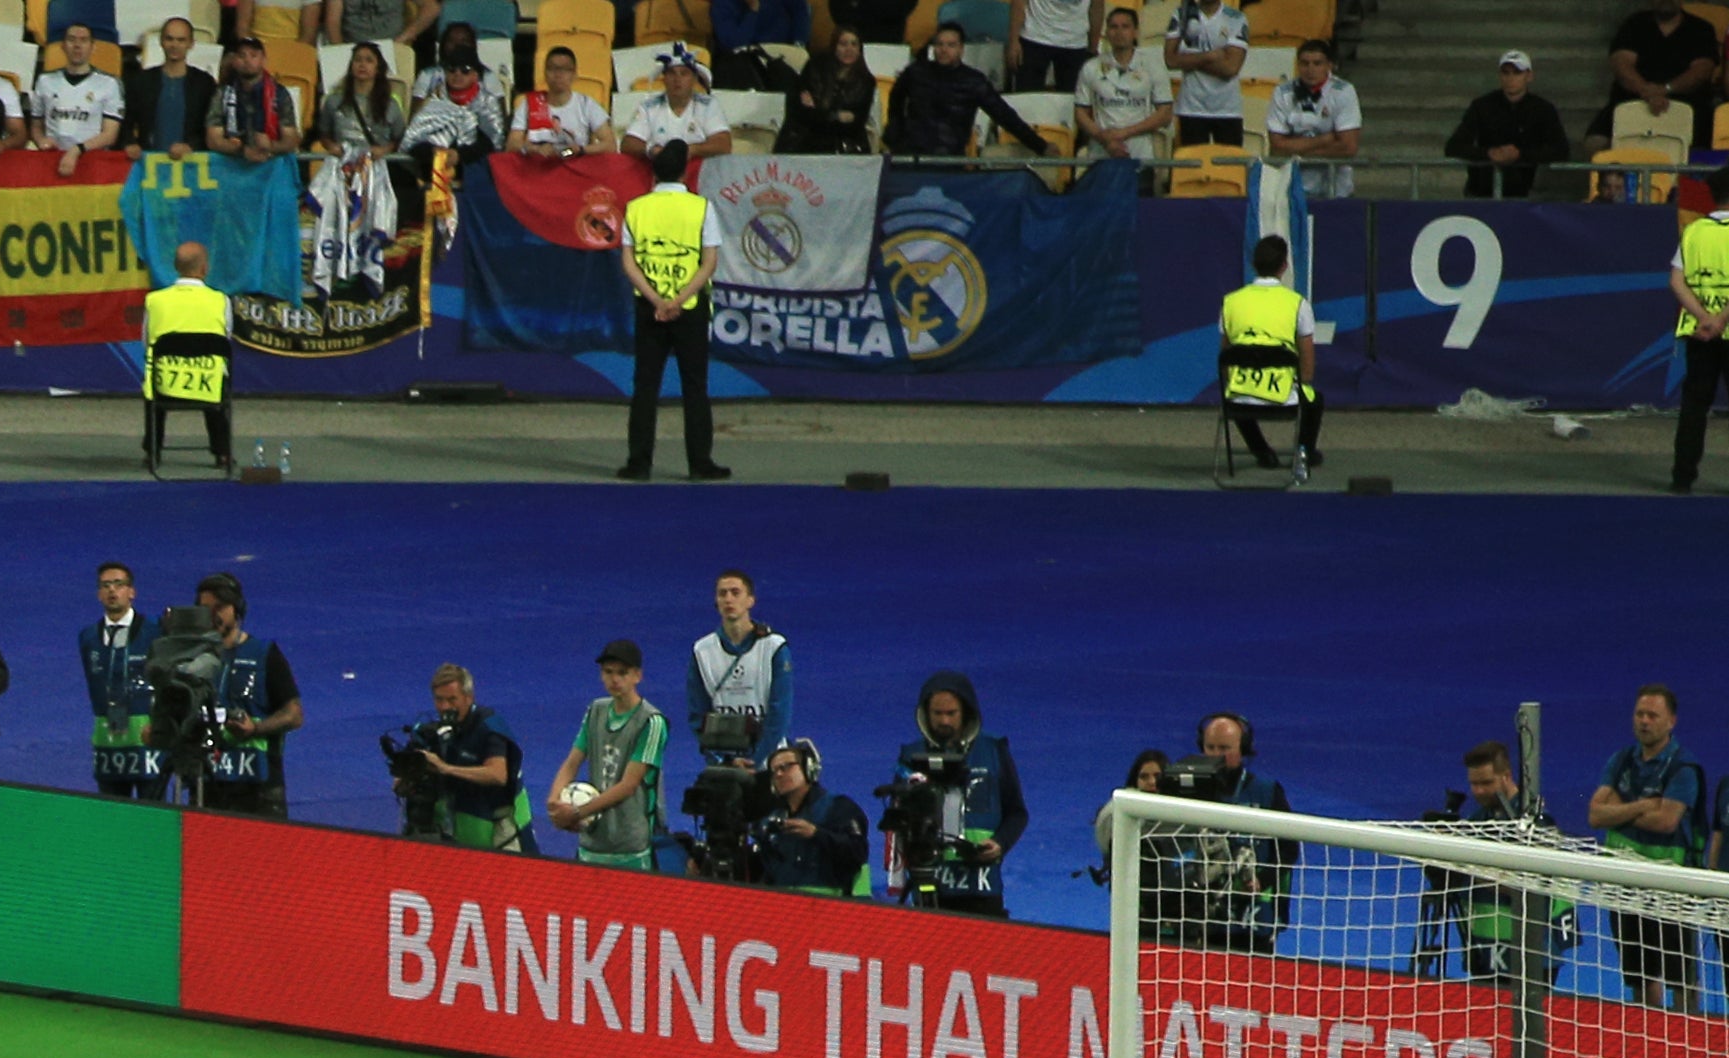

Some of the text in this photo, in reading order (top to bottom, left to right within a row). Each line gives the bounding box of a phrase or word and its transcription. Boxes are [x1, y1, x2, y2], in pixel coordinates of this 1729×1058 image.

[50, 106, 89, 122] bwin
[720, 163, 825, 208] REAL MADRID
[0, 219, 147, 280] CONFI
[713, 289, 886, 321] ADRIDISTA
[708, 310, 894, 358] ORELLA
[389, 888, 780, 1054] BANKING
